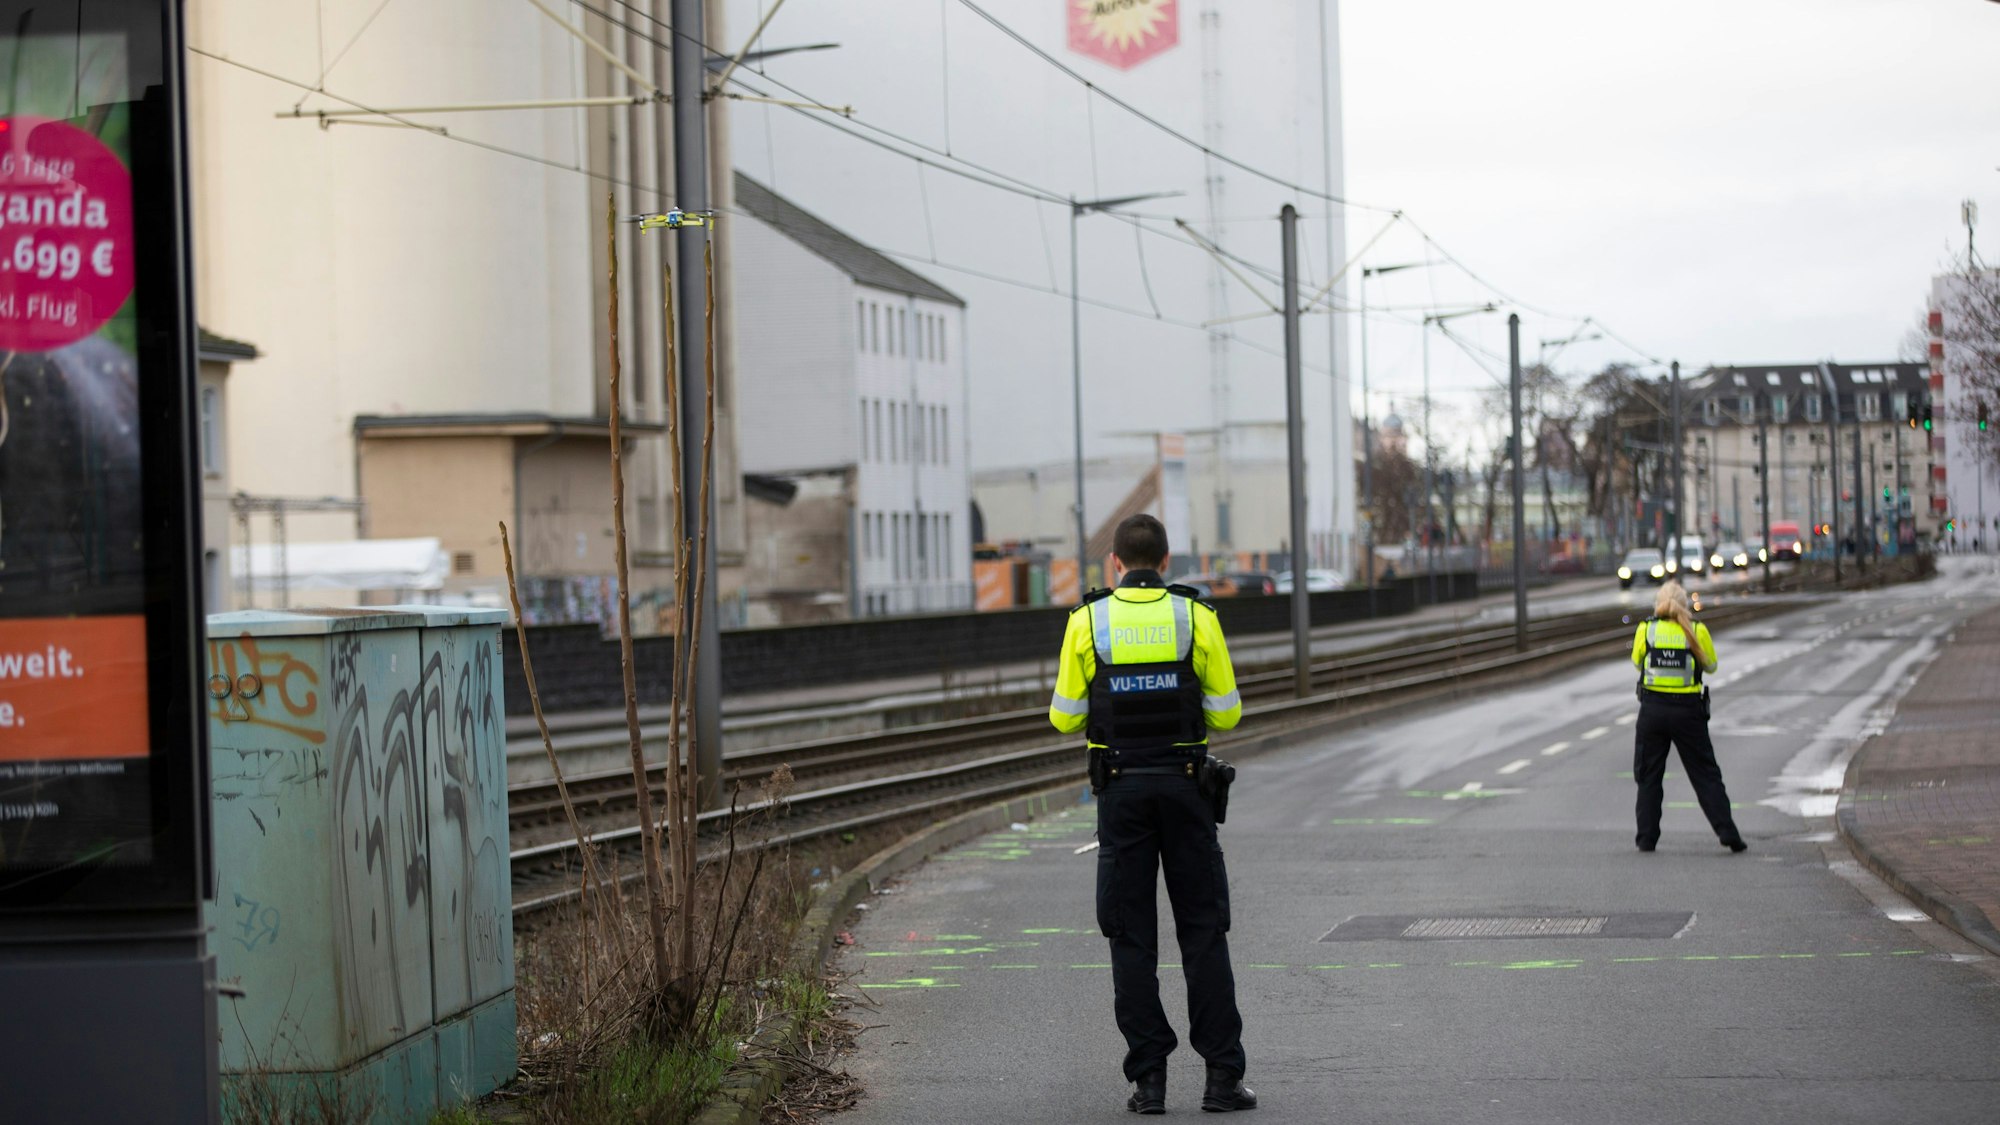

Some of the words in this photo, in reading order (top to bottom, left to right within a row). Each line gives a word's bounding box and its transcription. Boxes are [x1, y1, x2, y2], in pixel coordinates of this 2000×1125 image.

[23, 152, 76, 184] Tage
[0, 189, 109, 230] anda
[91, 239, 114, 277] €
[26, 293, 78, 328] Flug
[1114, 625, 1172, 646] POLIZEI
[1656, 658, 1680, 666] Team
[1662, 650, 1675, 658] VU
[1110, 673, 1178, 691] VU-TEAM
